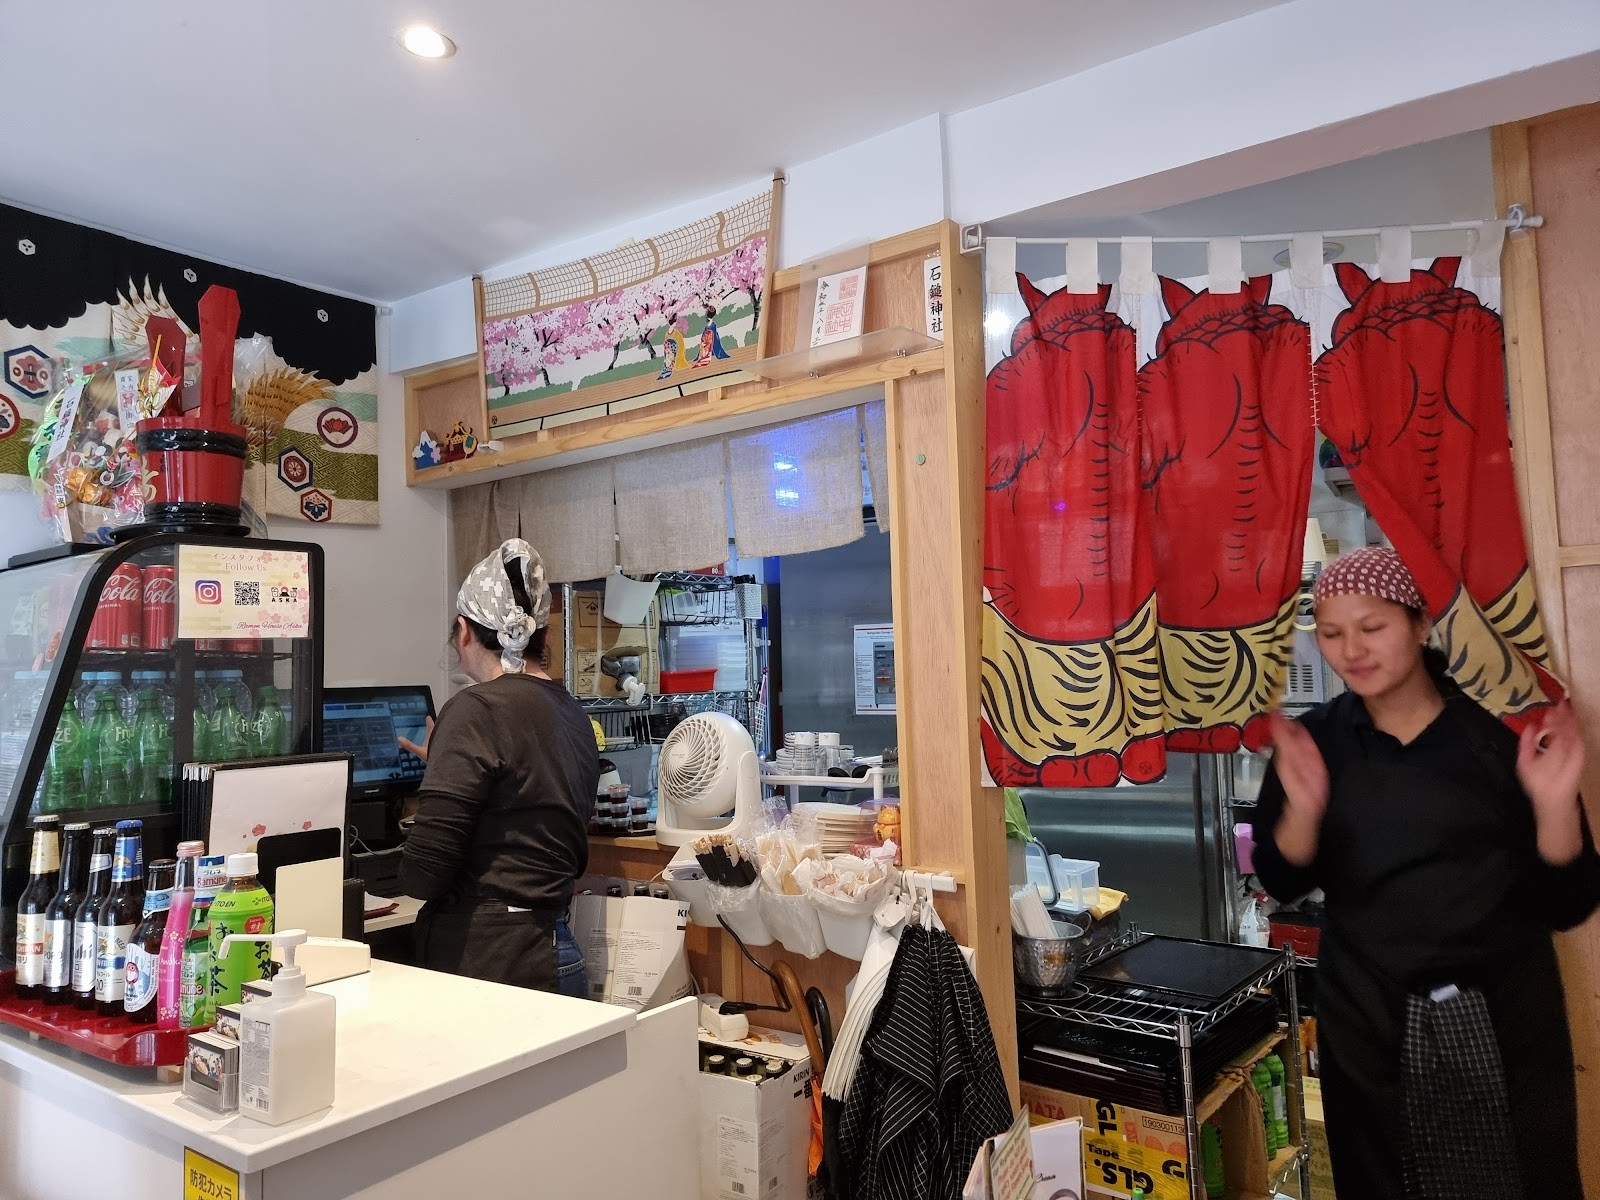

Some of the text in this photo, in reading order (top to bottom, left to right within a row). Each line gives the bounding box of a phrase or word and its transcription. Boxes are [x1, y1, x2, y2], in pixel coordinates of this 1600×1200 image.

[225, 562, 267, 572] Follow Us
[793, 1068, 810, 1084] KIRIN
[190, 1168, 232, 1200] 防犯カメラ
